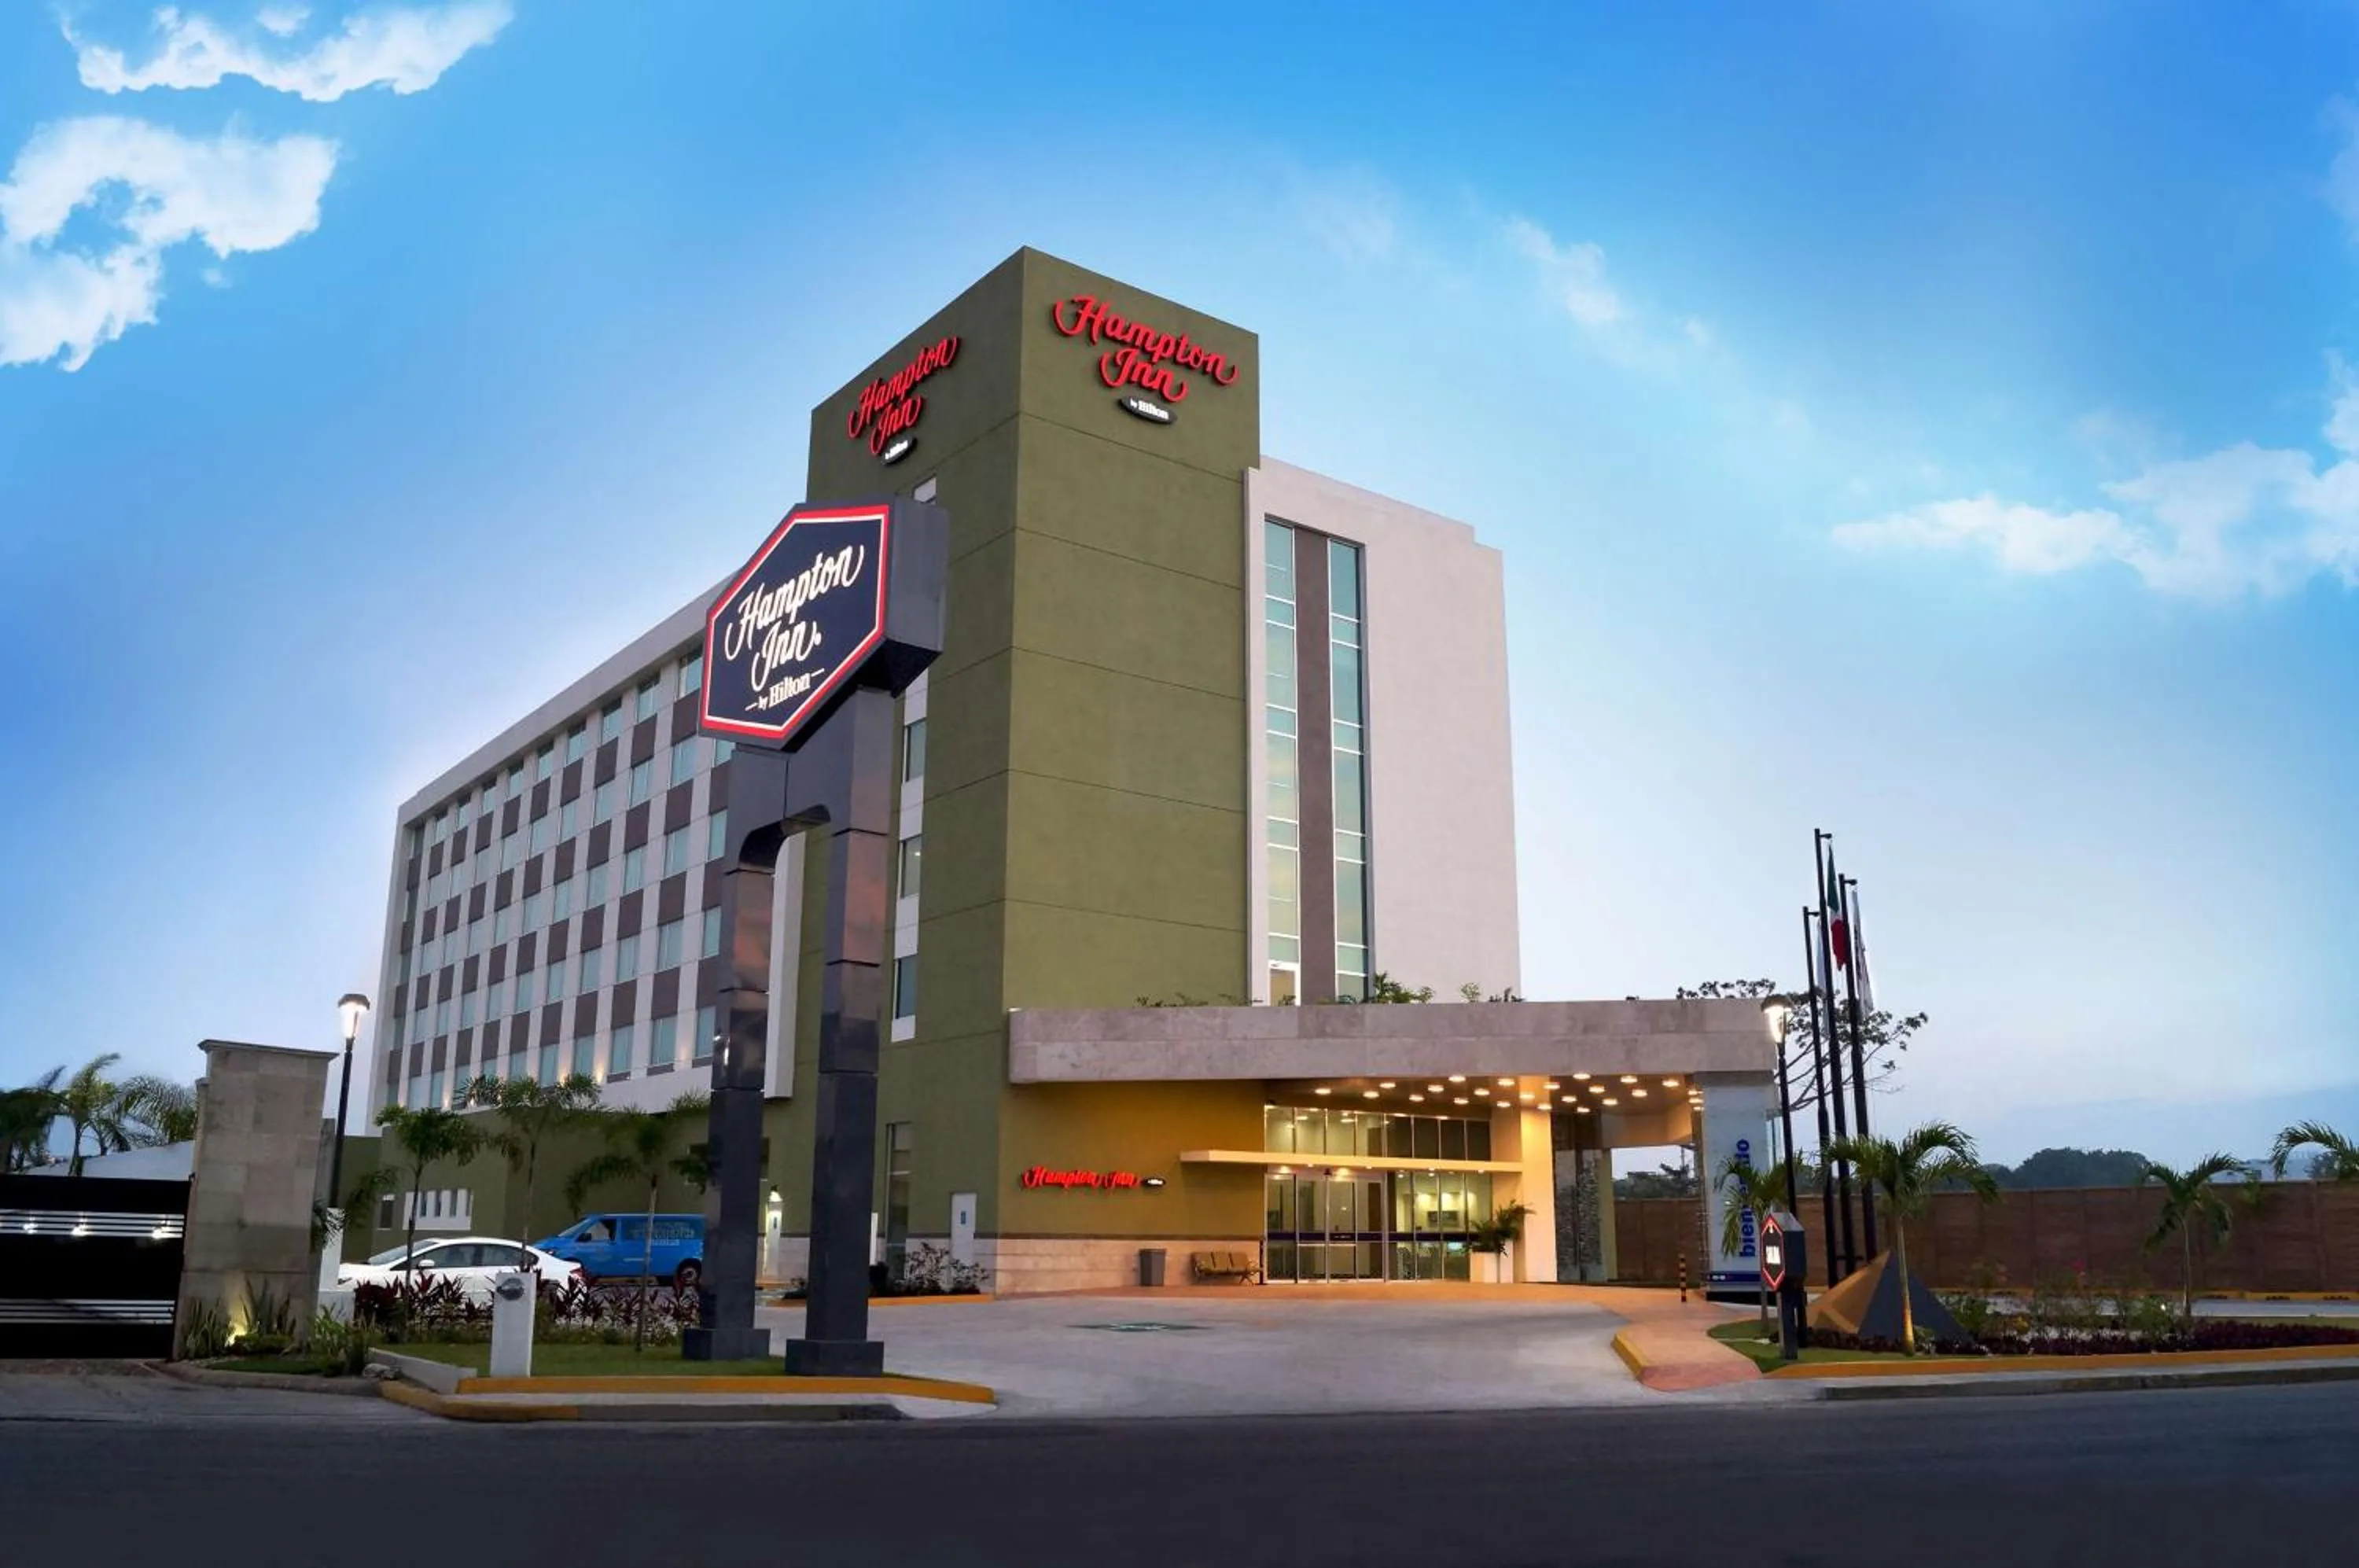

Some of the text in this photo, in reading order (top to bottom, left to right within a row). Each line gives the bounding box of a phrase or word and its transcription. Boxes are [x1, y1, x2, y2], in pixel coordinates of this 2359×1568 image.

[1053, 293, 1239, 385] Hampton
[847, 335, 959, 439] Hampton
[1099, 348, 1189, 403] Inn
[869, 395, 923, 456] Inn
[724, 544, 864, 661] Hampton
[768, 672, 811, 708] Hilton
[1024, 1165, 1140, 1190] Hampton Inn
